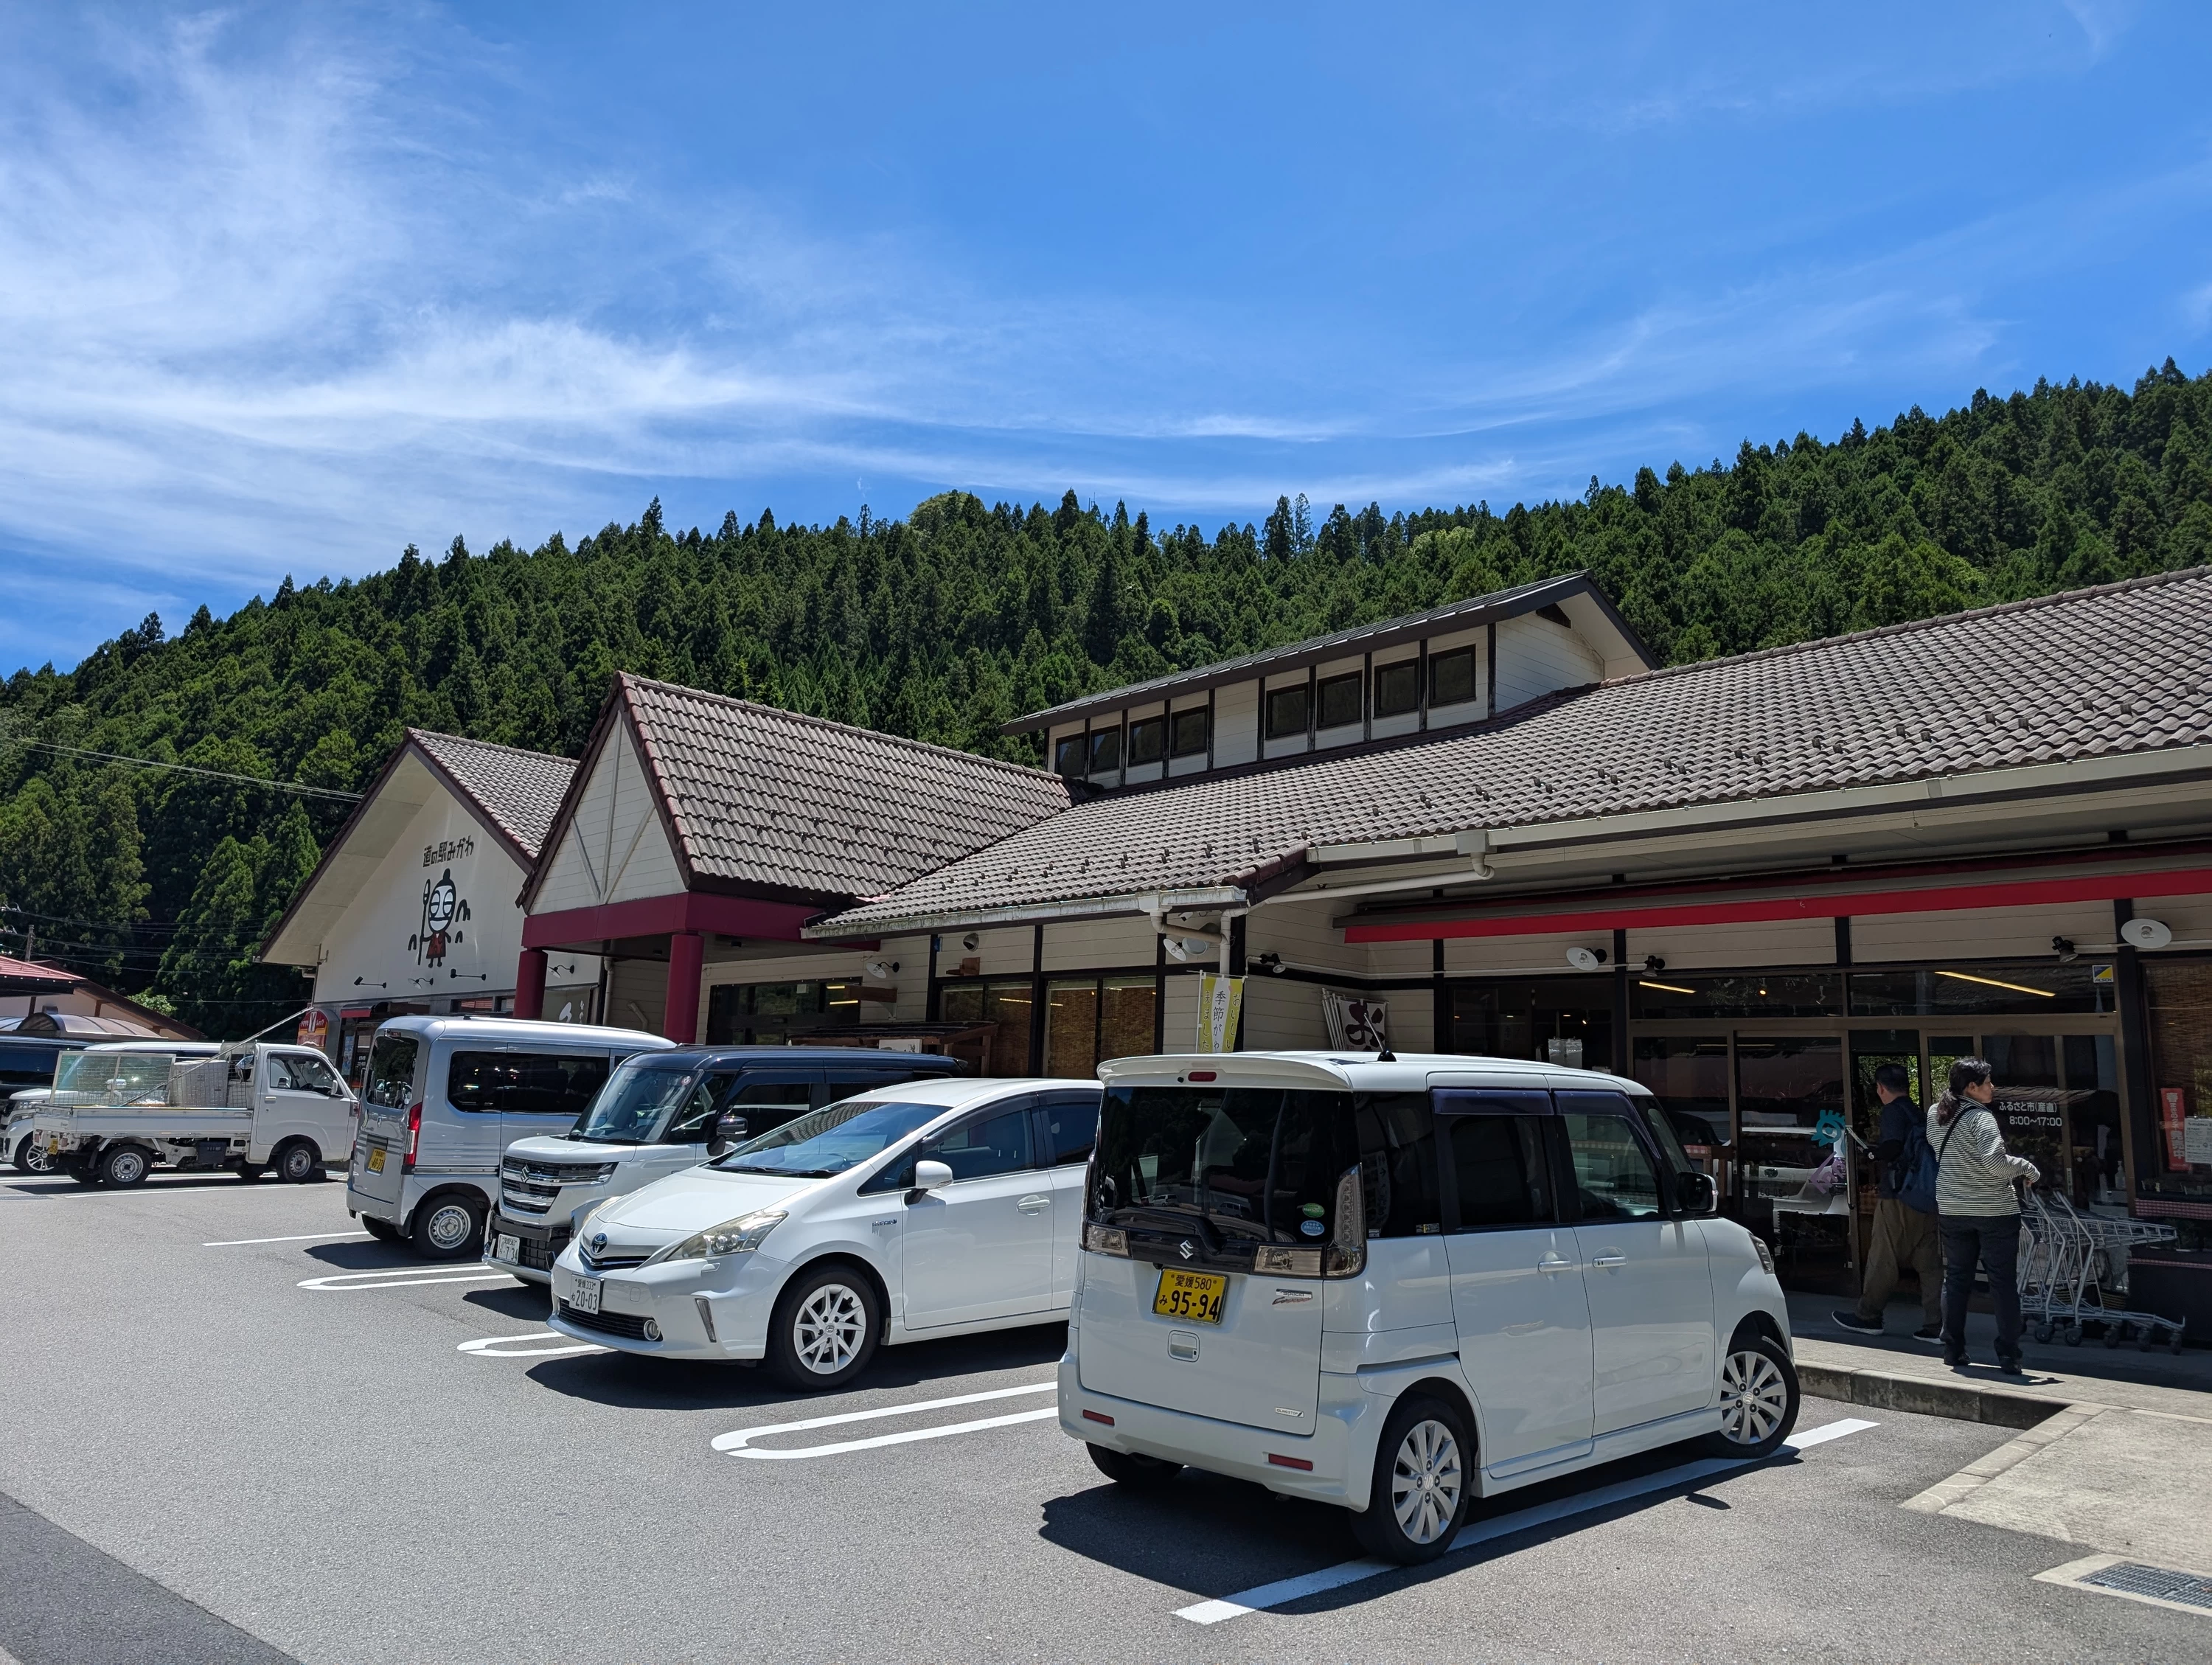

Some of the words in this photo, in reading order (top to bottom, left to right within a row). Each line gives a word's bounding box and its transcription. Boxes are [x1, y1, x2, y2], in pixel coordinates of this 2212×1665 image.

[1346, 1001, 1385, 1051] お
[1999, 1101, 2057, 1113] ふるさと市(産直)
[1175, 1274, 1212, 1290] 愛媛580
[1158, 1295, 1168, 1305] み
[1169, 1290, 1220, 1320] 95-94
